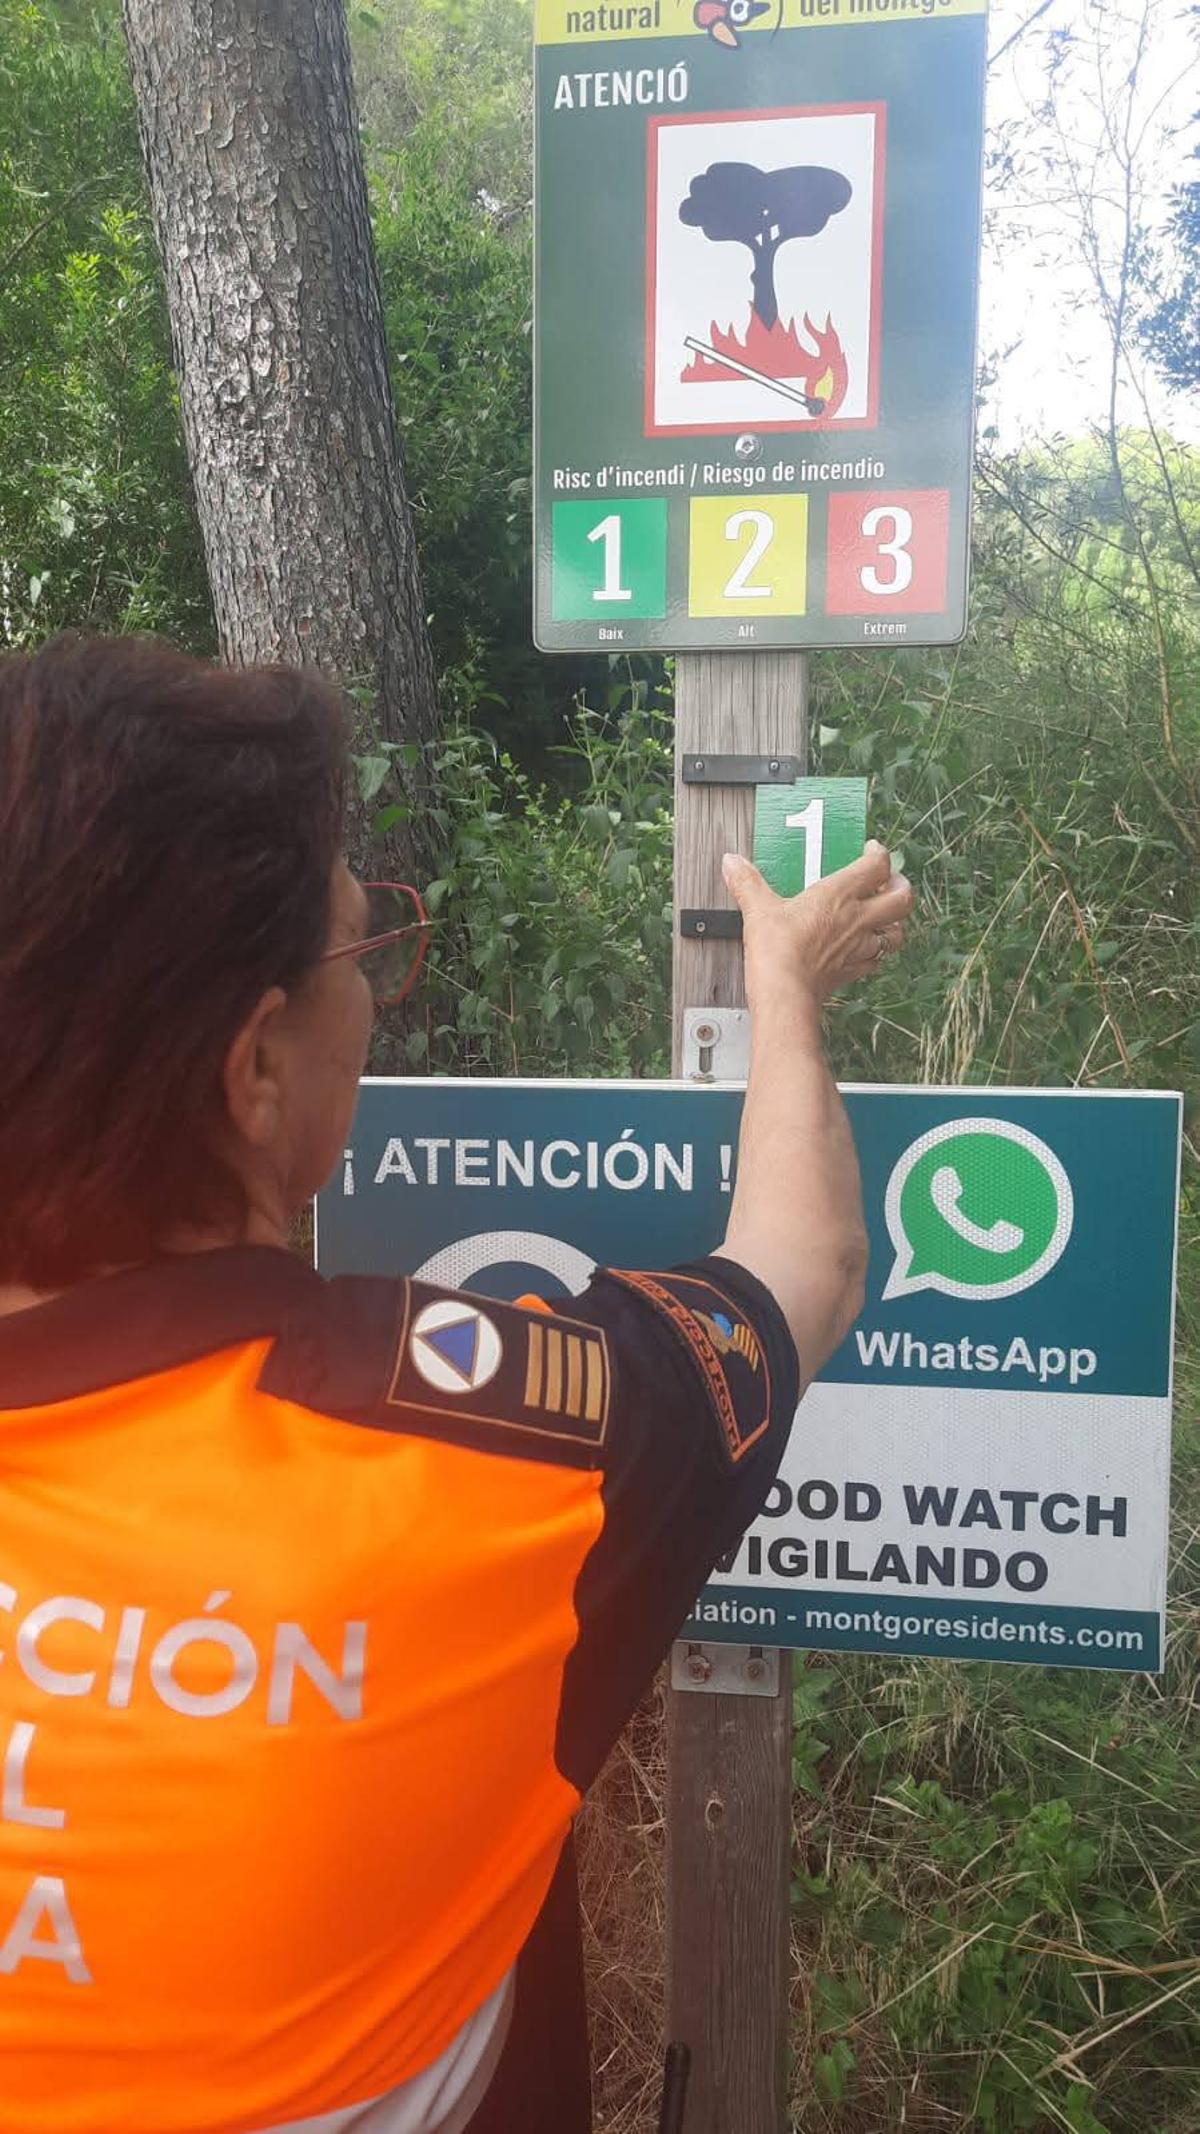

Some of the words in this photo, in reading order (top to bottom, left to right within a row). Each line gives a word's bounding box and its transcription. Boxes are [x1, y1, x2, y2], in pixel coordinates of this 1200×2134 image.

[567, 0, 660, 33] natural
[554, 61, 688, 109] ATENCIÓ
[553, 467, 591, 489] Risc
[596, 463, 684, 487] d'incendi
[690, 463, 698, 488] /
[703, 462, 766, 487] Riesgo
[772, 461, 795, 481] de
[801, 457, 885, 481] incendio
[587, 515, 631, 600] 1
[722, 510, 773, 598] 2
[859, 506, 913, 595] 3
[598, 627, 624, 641] Baix
[738, 624, 755, 637] Alt
[863, 621, 907, 636] Extrem
[785, 798, 824, 890] 1
[343, 1148, 354, 1195] ¡
[374, 1129, 693, 1191] ATENCIÓN
[719, 1144, 732, 1191] !
[855, 1330, 1097, 1384] WhatsApp
[903, 1485, 1128, 1537] WATCH
[686, 1598, 776, 1625] iation
[786, 1613, 797, 1621] -
[805, 1608, 1144, 1650] montgoresidents.com
[0, 1582, 368, 1725] CIÓN
[0, 1876, 93, 1985] A
